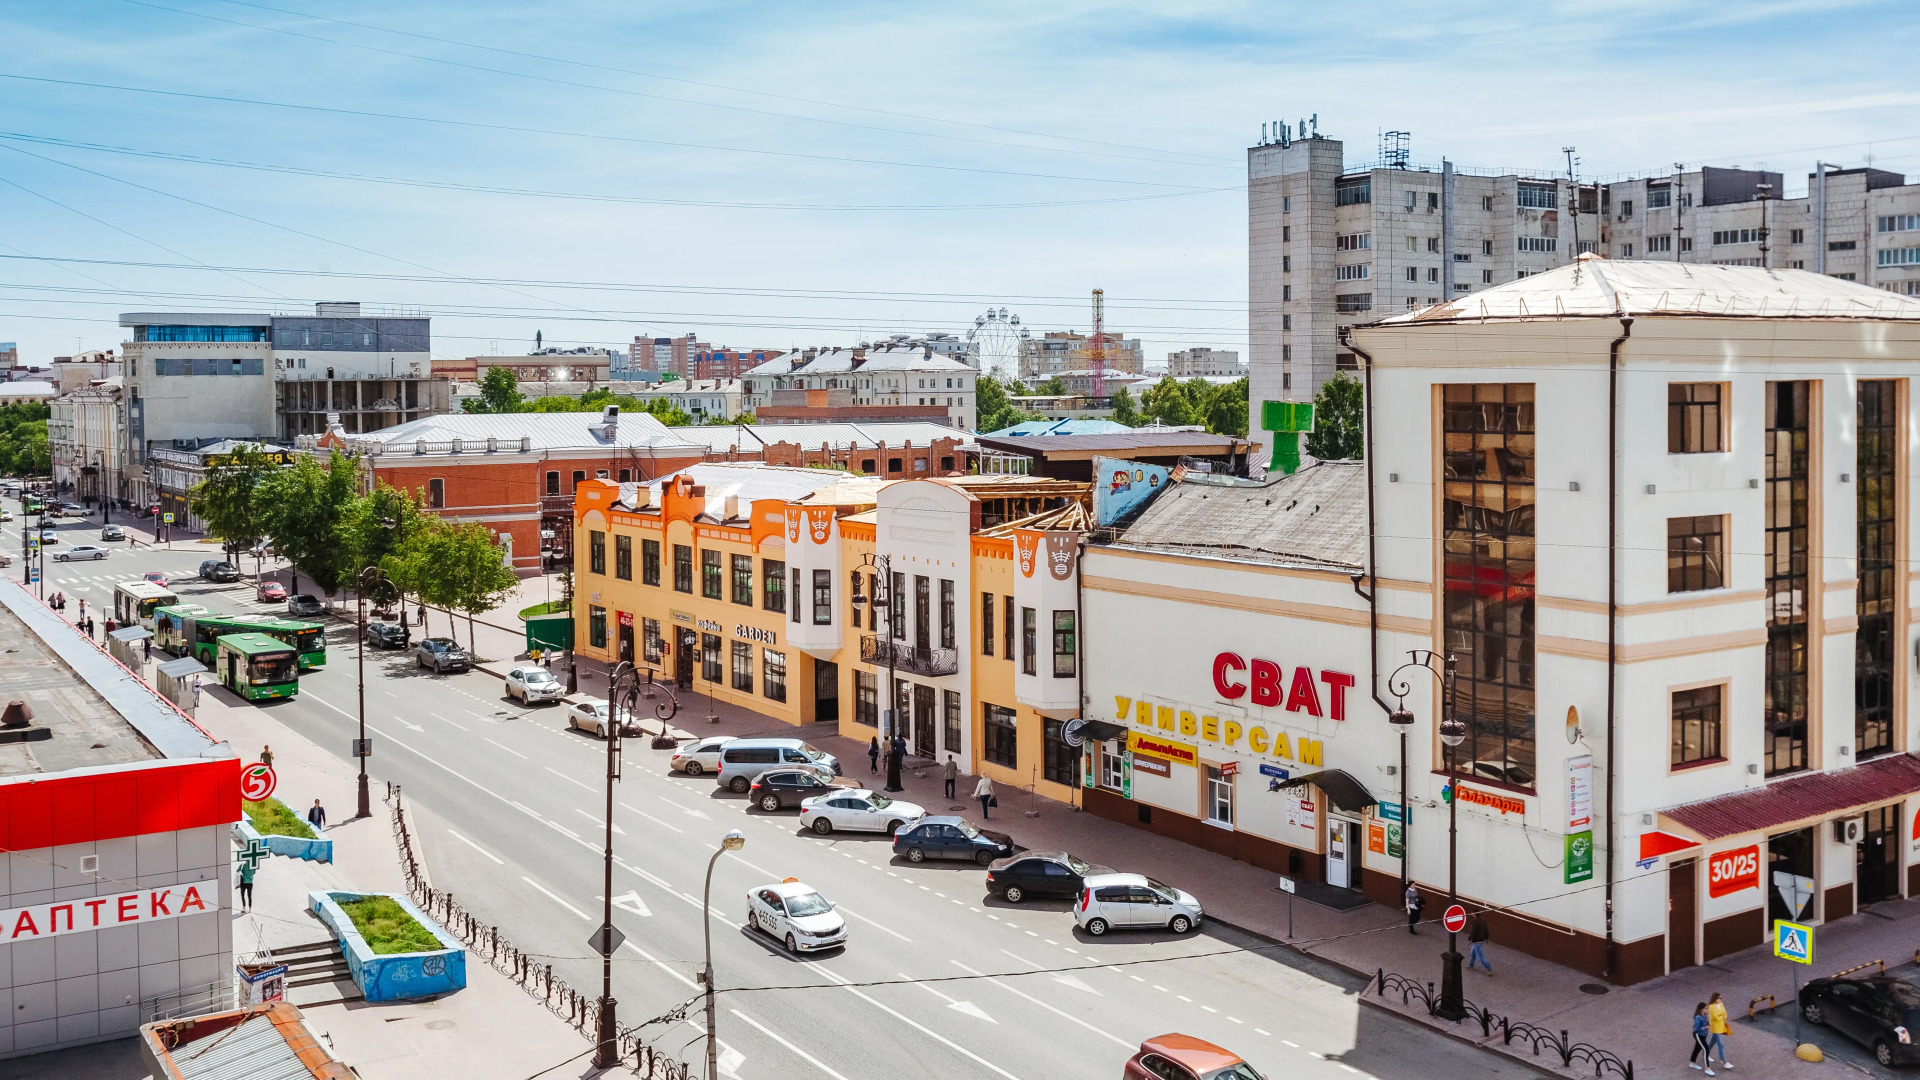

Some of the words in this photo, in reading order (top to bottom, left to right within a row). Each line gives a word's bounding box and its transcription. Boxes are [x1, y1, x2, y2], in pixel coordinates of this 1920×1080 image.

[735, 623, 776, 645] GARDEN
[1212, 651, 1356, 721] СВАТ
[1114, 695, 1324, 768] УНИВЕРСАМ
[1455, 785, 1525, 815] Галамарт
[1712, 852, 1757, 882] 30/25
[11, 886, 206, 939] АПТЕКА
